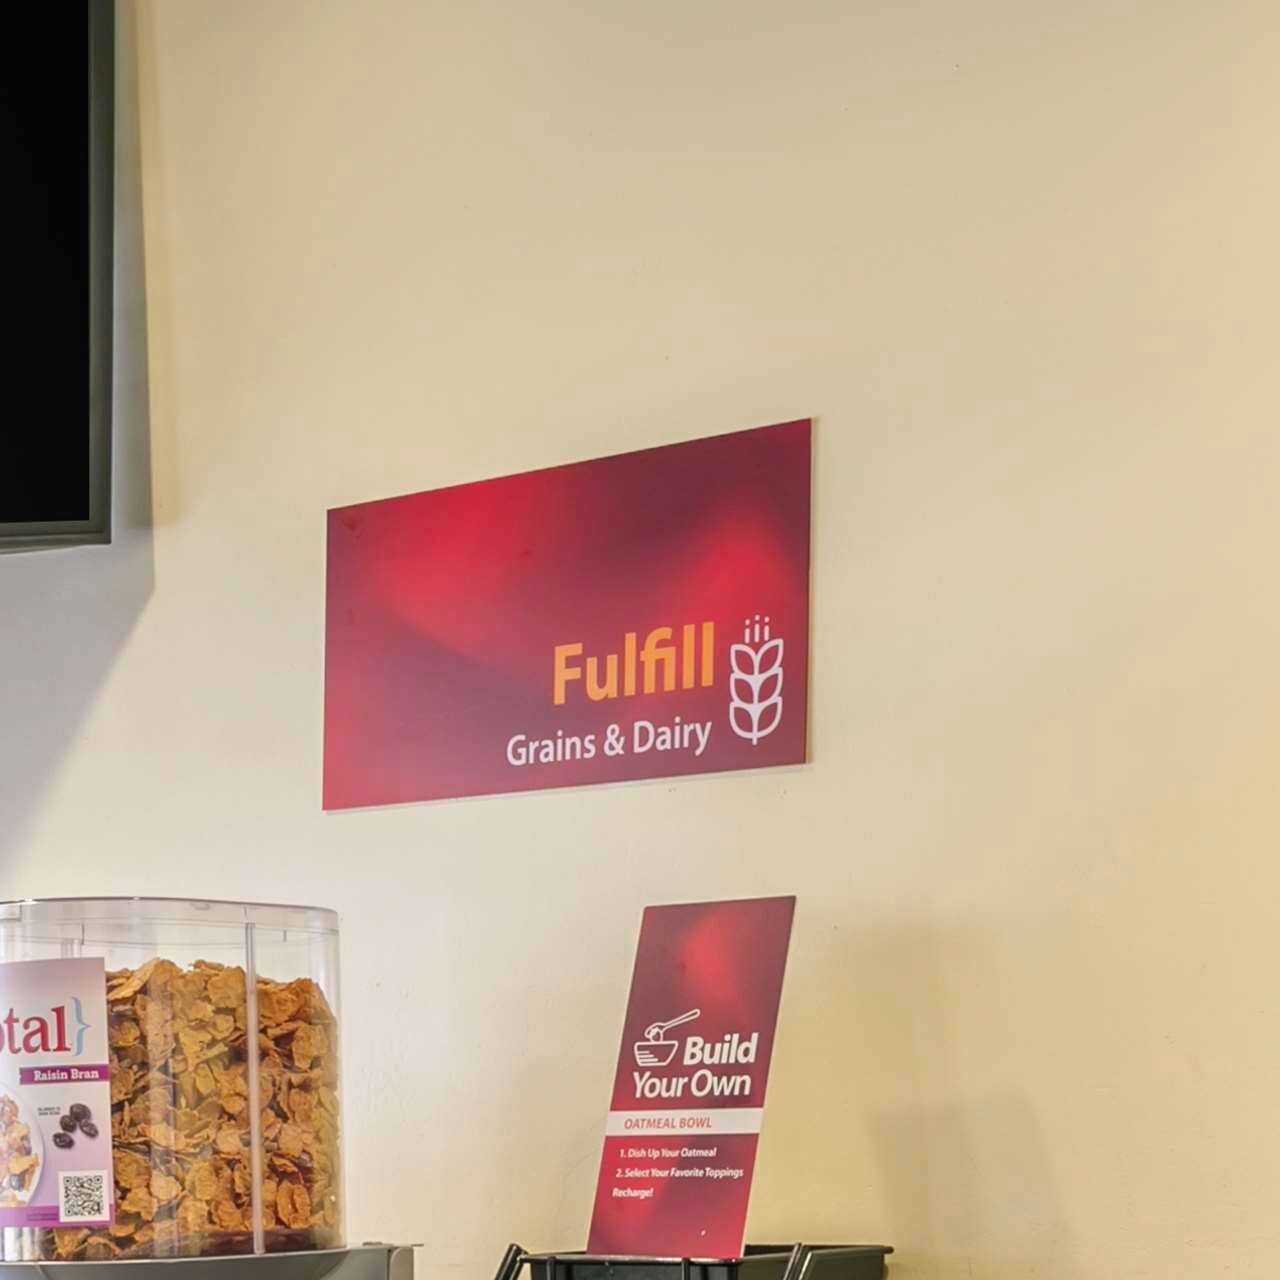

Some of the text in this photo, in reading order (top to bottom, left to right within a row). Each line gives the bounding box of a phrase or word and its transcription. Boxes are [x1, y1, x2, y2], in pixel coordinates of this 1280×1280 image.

[553, 621, 714, 705] Fulfill
[506, 717, 712, 767] Grains & Dairy
[683, 1032, 759, 1066] Build
[33, 1068, 99, 1081] Raisin Bran
[632, 1069, 752, 1099] Your Own
[624, 1116, 712, 1129] OATMEAL BOWL
[628, 1148, 646, 1158] Dish
[648, 1149, 660, 1159] Up
[661, 1148, 680, 1158] Your
[681, 1147, 717, 1157] Oatmeal
[624, 1167, 650, 1178] Select
[651, 1168, 670, 1177] Your
[671, 1167, 705, 1177] Favorite
[706, 1167, 744, 1179] Toppings
